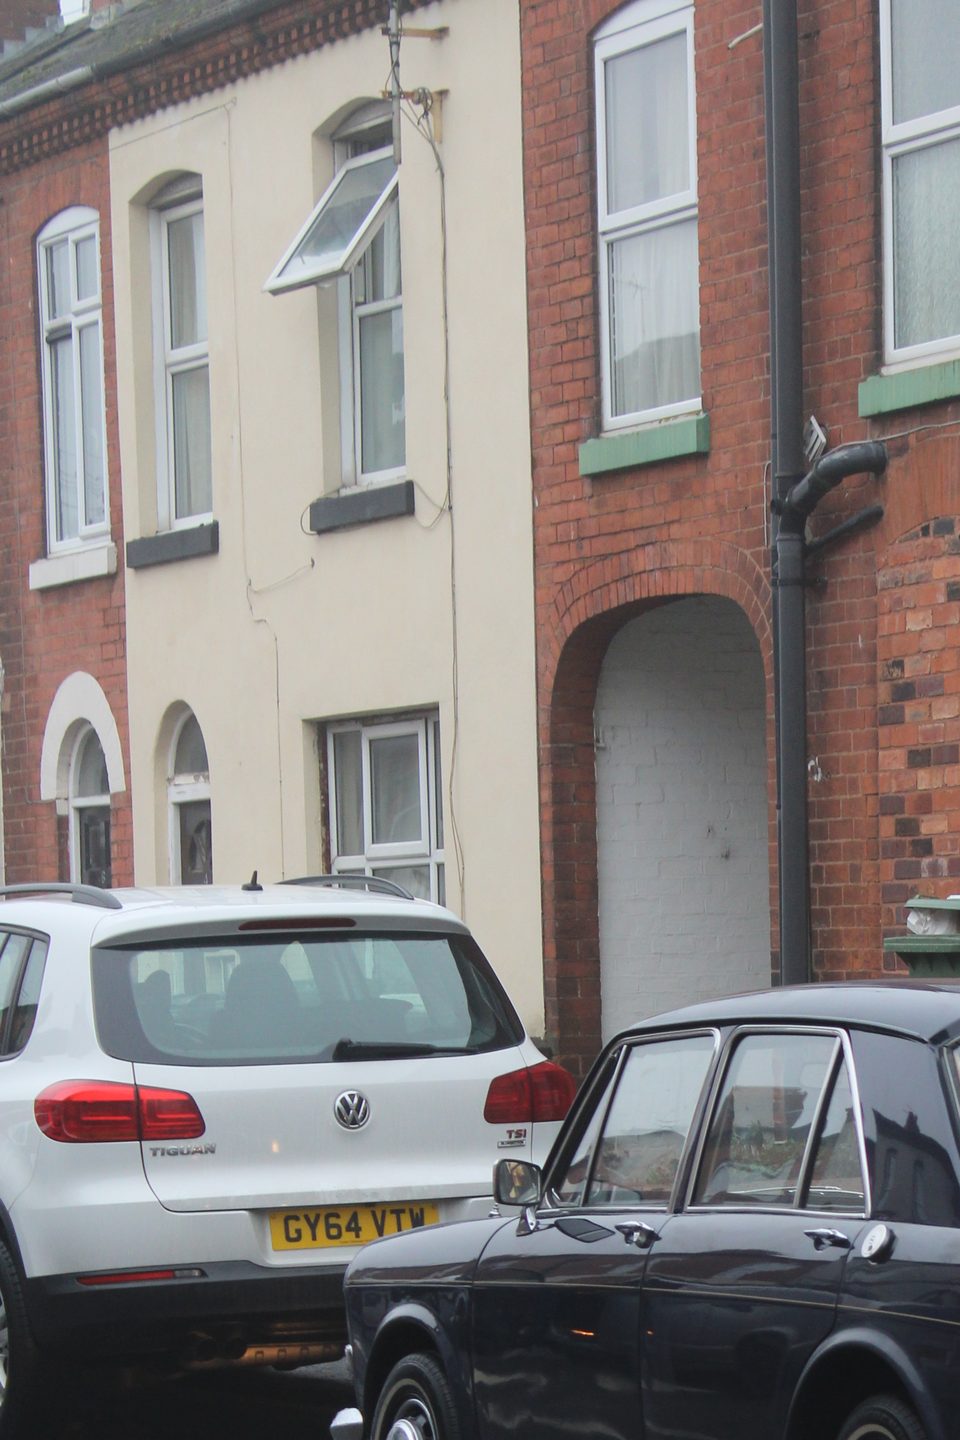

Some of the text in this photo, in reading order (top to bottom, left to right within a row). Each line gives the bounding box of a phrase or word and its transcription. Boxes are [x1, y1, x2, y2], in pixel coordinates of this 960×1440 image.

[506, 1129, 527, 1139] TSI
[150, 1142, 216, 1158] TIGUAN
[283, 1207, 425, 1243] GY64 VTW
